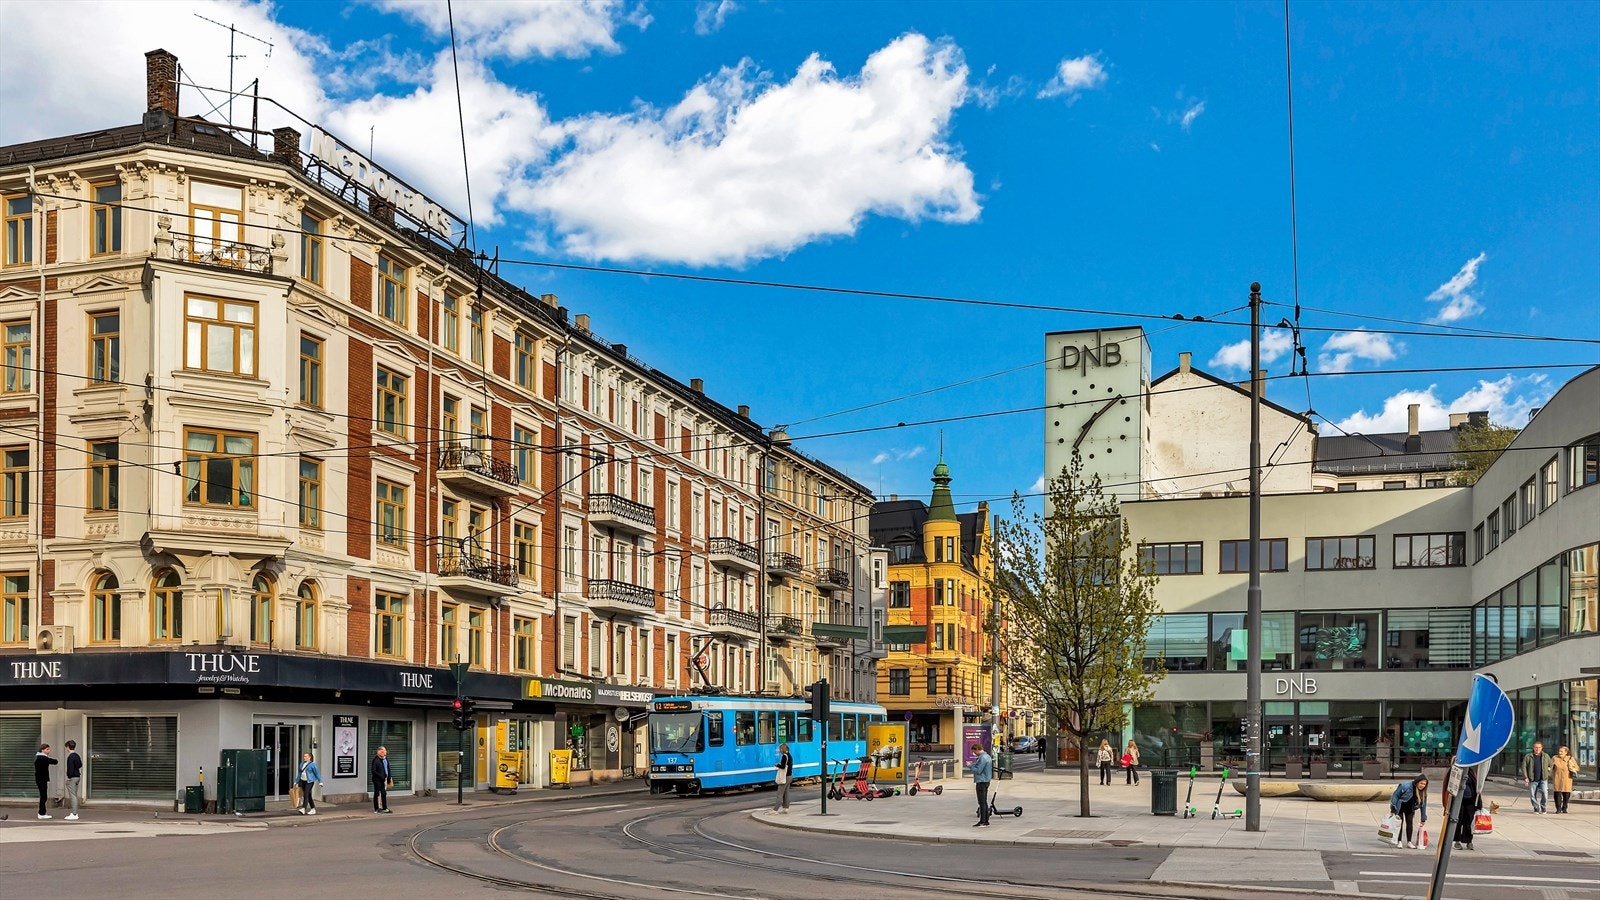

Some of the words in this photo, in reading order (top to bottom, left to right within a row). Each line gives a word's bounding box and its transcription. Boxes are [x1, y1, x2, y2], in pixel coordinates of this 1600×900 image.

[1063, 329, 1121, 376] DNB
[10, 661, 62, 679] THUNE
[185, 653, 261, 673] THUNE
[399, 672, 433, 689] THUNE
[1276, 672, 1317, 700] DNB
[542, 683, 592, 700] McDonald's
[339, 716, 354, 724] THUNE
